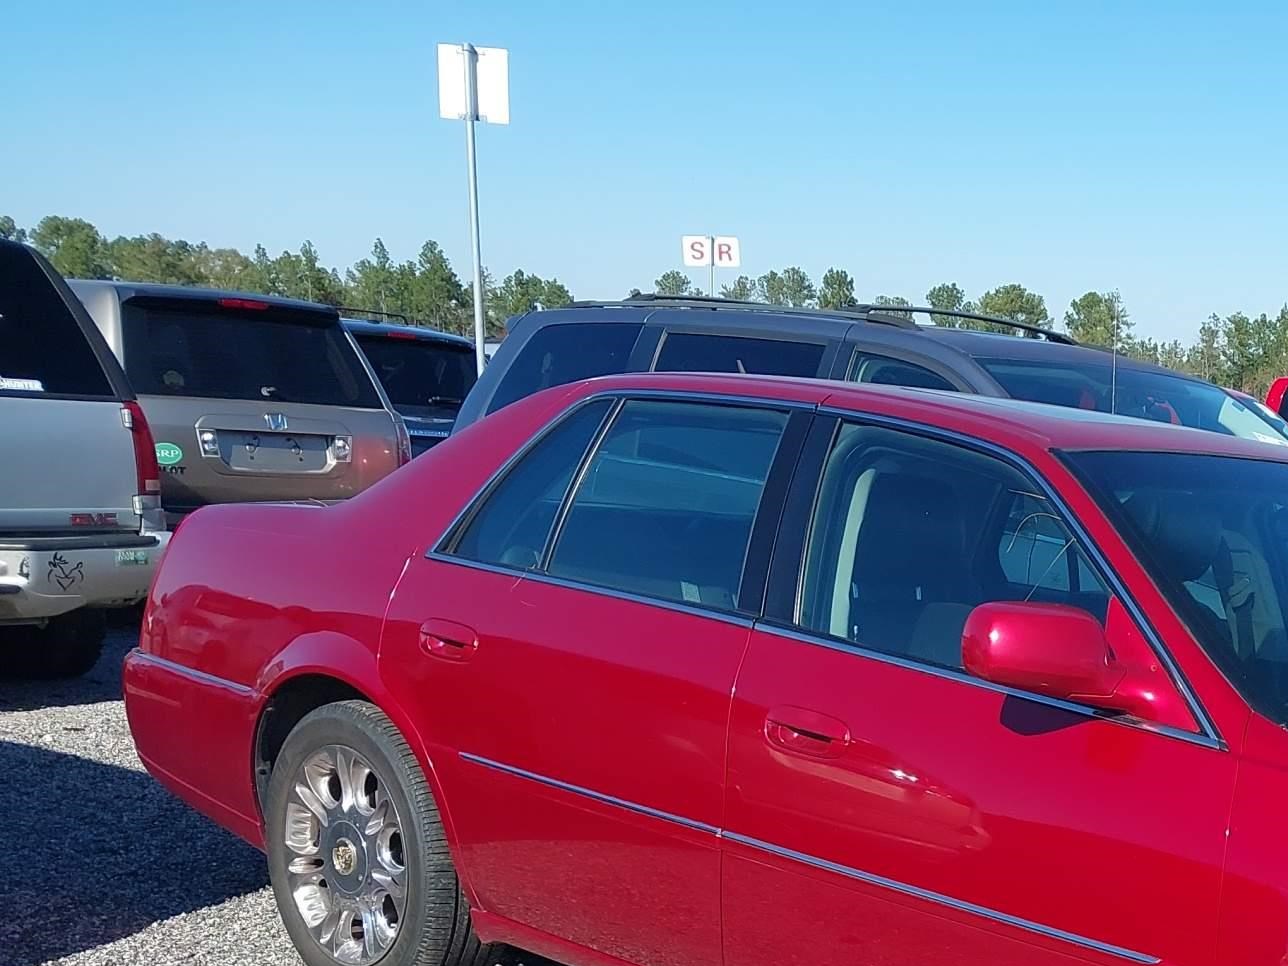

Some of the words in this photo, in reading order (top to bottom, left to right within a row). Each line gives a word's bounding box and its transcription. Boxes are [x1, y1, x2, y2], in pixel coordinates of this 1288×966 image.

[690, 241, 705, 260] S
[718, 243, 732, 261] R
[70, 512, 119, 528] GMC
